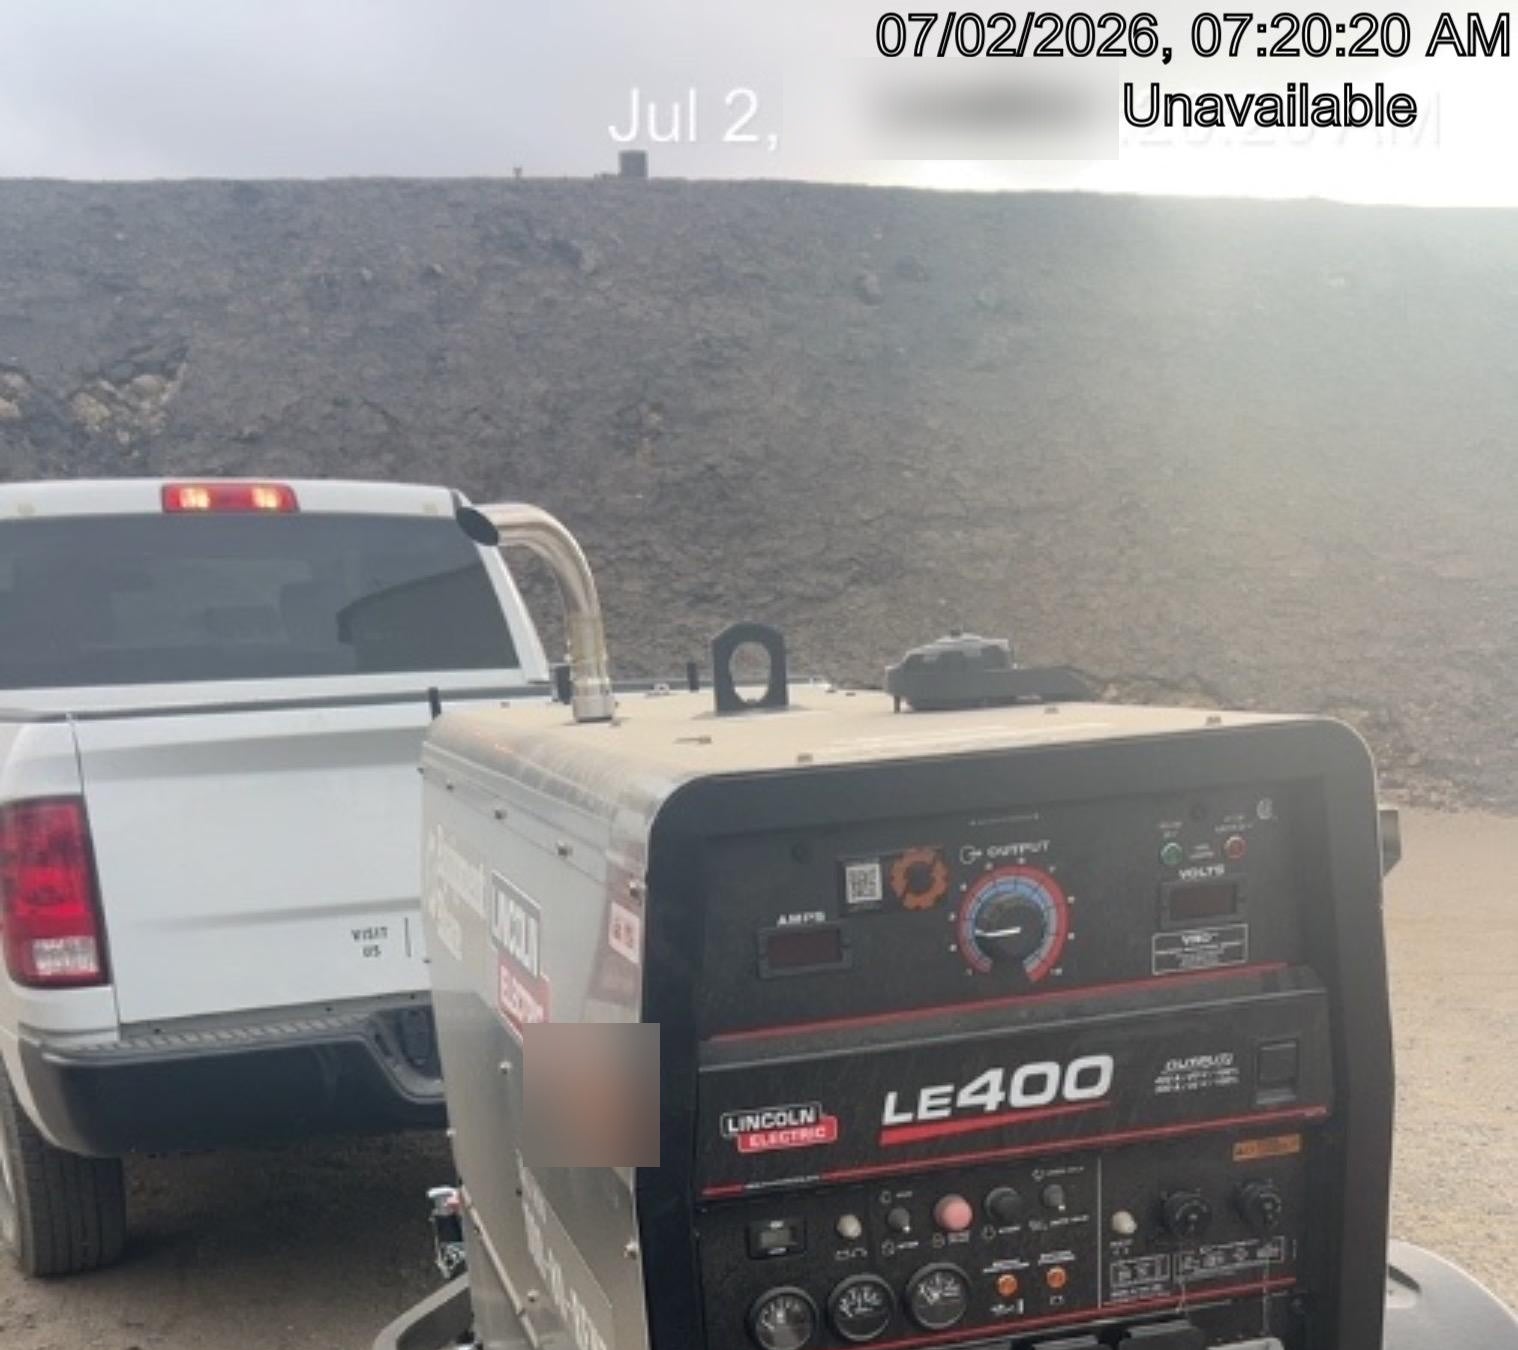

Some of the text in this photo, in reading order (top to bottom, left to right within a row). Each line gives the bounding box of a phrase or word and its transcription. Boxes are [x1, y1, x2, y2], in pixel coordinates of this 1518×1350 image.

[1178, 863, 1225, 881] VOLTS
[776, 910, 826, 928] AMPS
[882, 1054, 1115, 1126] LE400
[727, 1108, 816, 1133] LINCOLN
[749, 1123, 827, 1148] ELECTRIC
